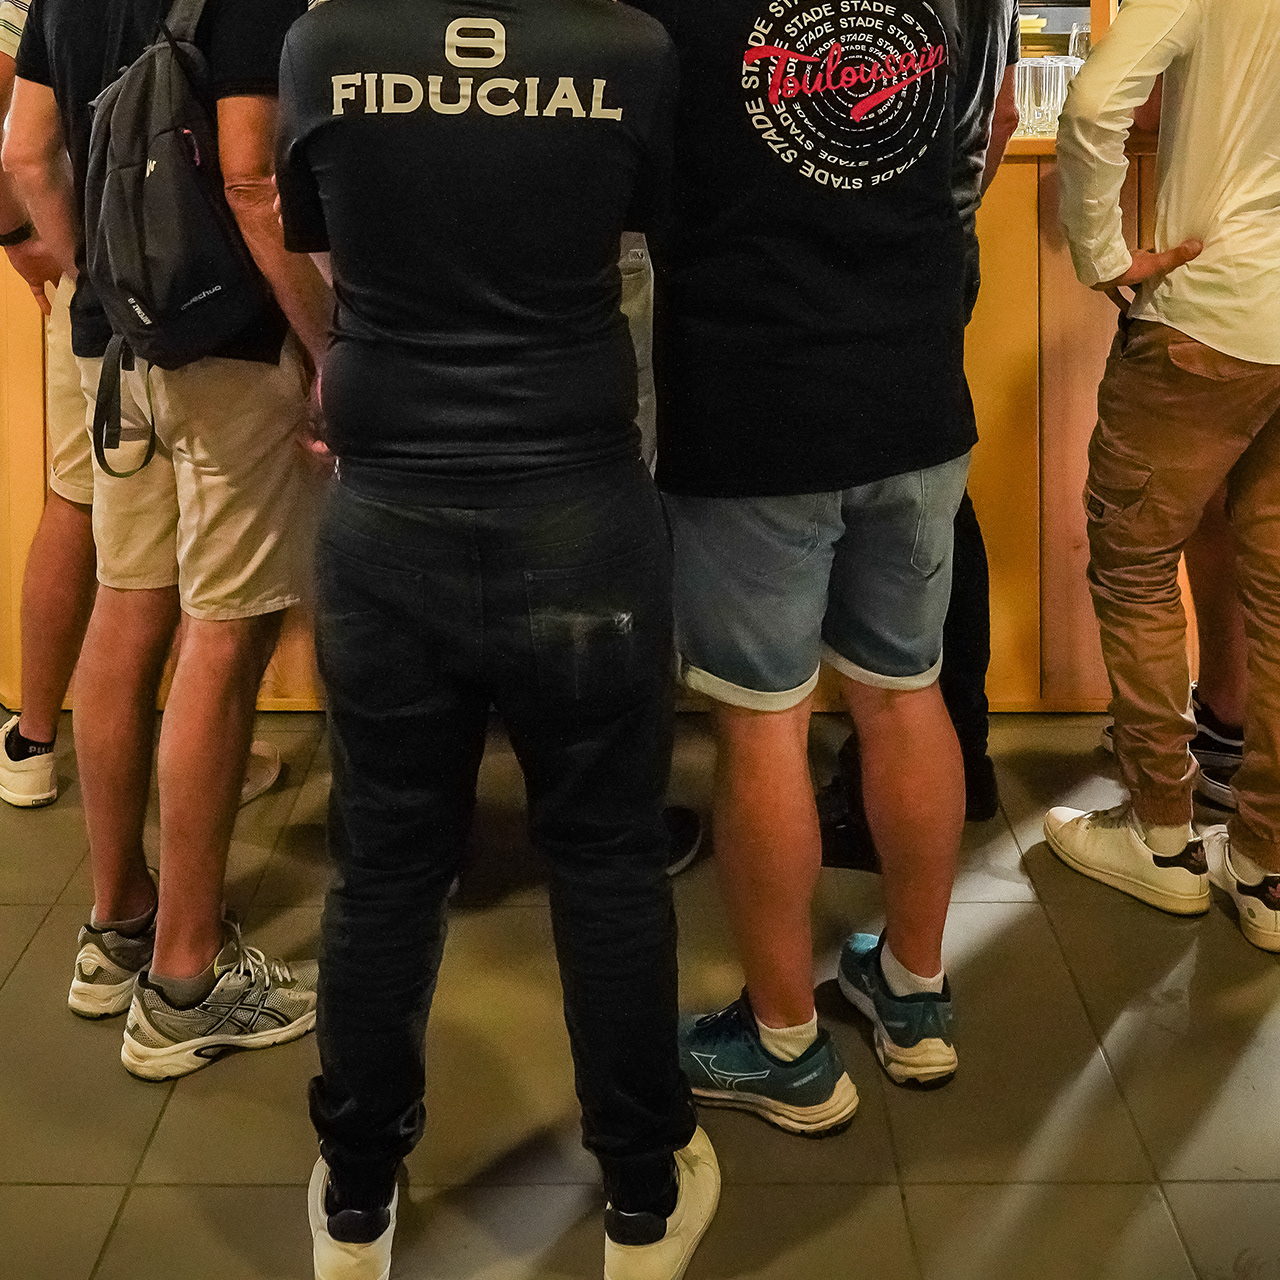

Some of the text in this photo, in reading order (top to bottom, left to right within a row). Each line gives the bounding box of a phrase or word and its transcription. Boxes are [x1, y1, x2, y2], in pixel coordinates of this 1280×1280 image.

[784, 3, 835, 37] STADE
[839, 16, 885, 30] STADE
[840, 0, 897, 17] STADE
[795, 22, 835, 52] STADE
[811, 38, 837, 58] TADE
[840, 32, 874, 43] STADE
[887, 24, 919, 58] STADE
[901, 13, 934, 51] STAD
[741, 17, 774, 89] STDE
[744, 42, 946, 105] Toulousain
[331, 73, 623, 121] FIDUCIAL
[745, 97, 798, 163] STADE
[772, 99, 815, 152] STADE
[792, 101, 826, 139] STADE
[799, 159, 863, 190] STADE
[818, 149, 869, 167] STADE
[871, 144, 928, 186] STADE
